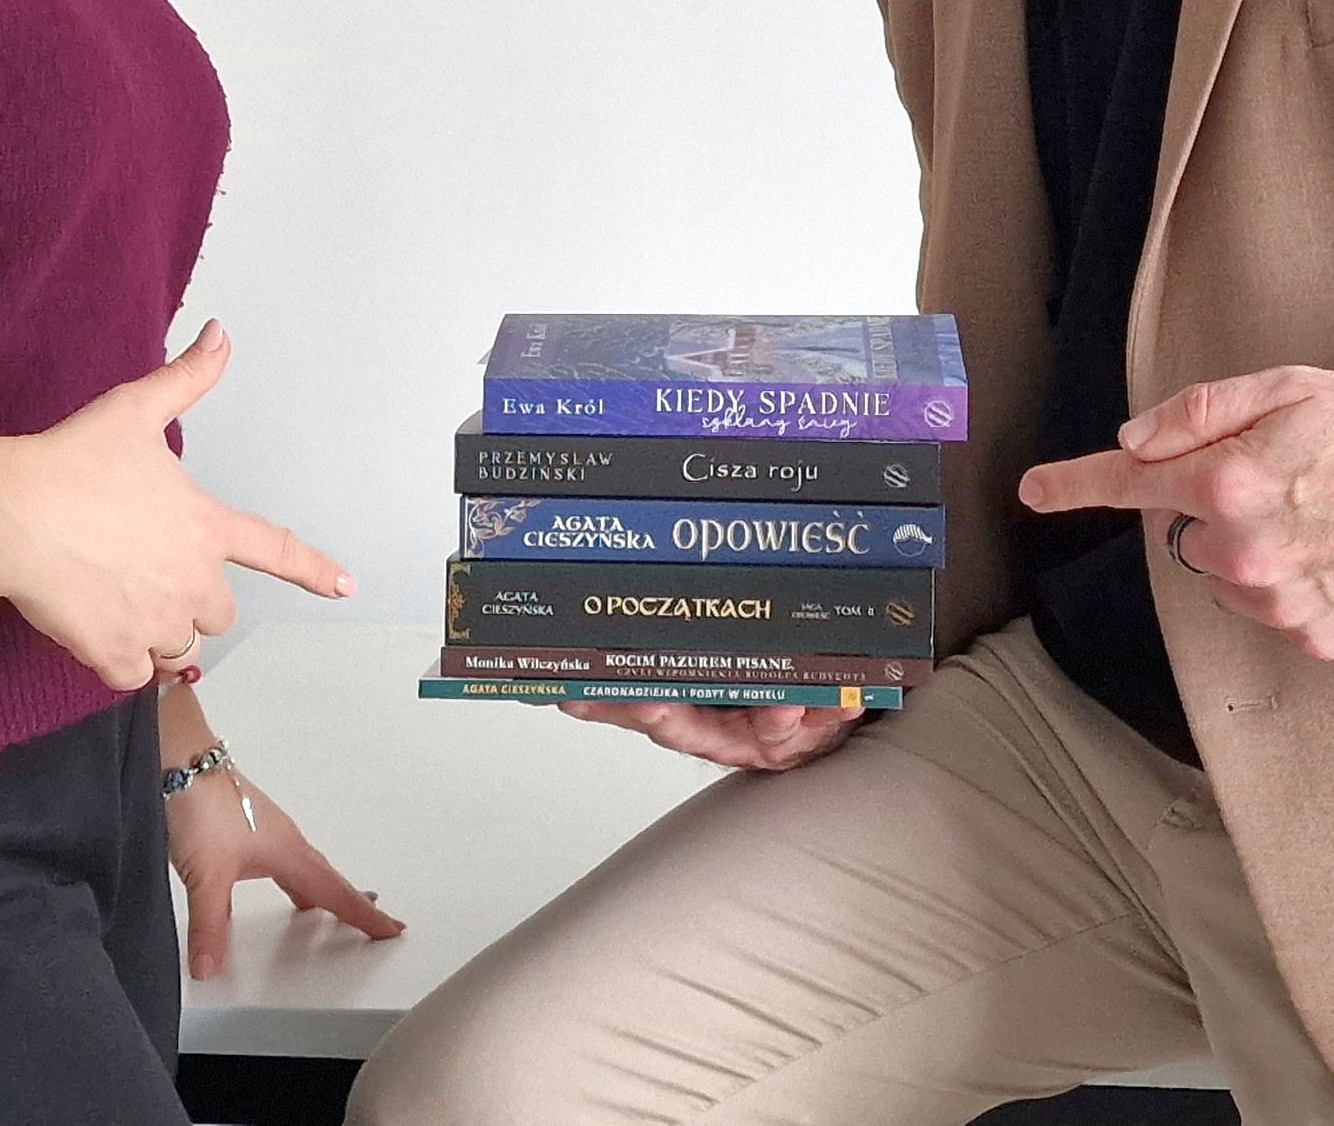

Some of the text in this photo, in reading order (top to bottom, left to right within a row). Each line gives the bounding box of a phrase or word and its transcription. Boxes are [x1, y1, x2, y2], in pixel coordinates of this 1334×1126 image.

[502, 398, 605, 415] Ewa Król
[655, 388, 891, 416] KIEDY SPADNIE
[478, 466, 586, 481] BUDZIŃSKI
[682, 453, 818, 492] Cisza roju
[551, 515, 625, 532] AGATA
[523, 530, 657, 550] CIESZYŃSKA
[672, 510, 872, 561] OPOWIEŚĆ
[495, 591, 539, 603] AGATA
[482, 603, 555, 617] CIESZYŃSKA
[583, 595, 772, 622] O POCZĄTKACH
[833, 604, 863, 616] TOM
[465, 656, 591, 673] Monika Wilczyńska
[605, 654, 655, 668] KOCIM
[659, 655, 733, 670] PAZUREM
[462, 684, 567, 695] AGATA CIESZYŃSKA
[728, 688, 740, 700] W
[743, 689, 786, 701] HOTELU
